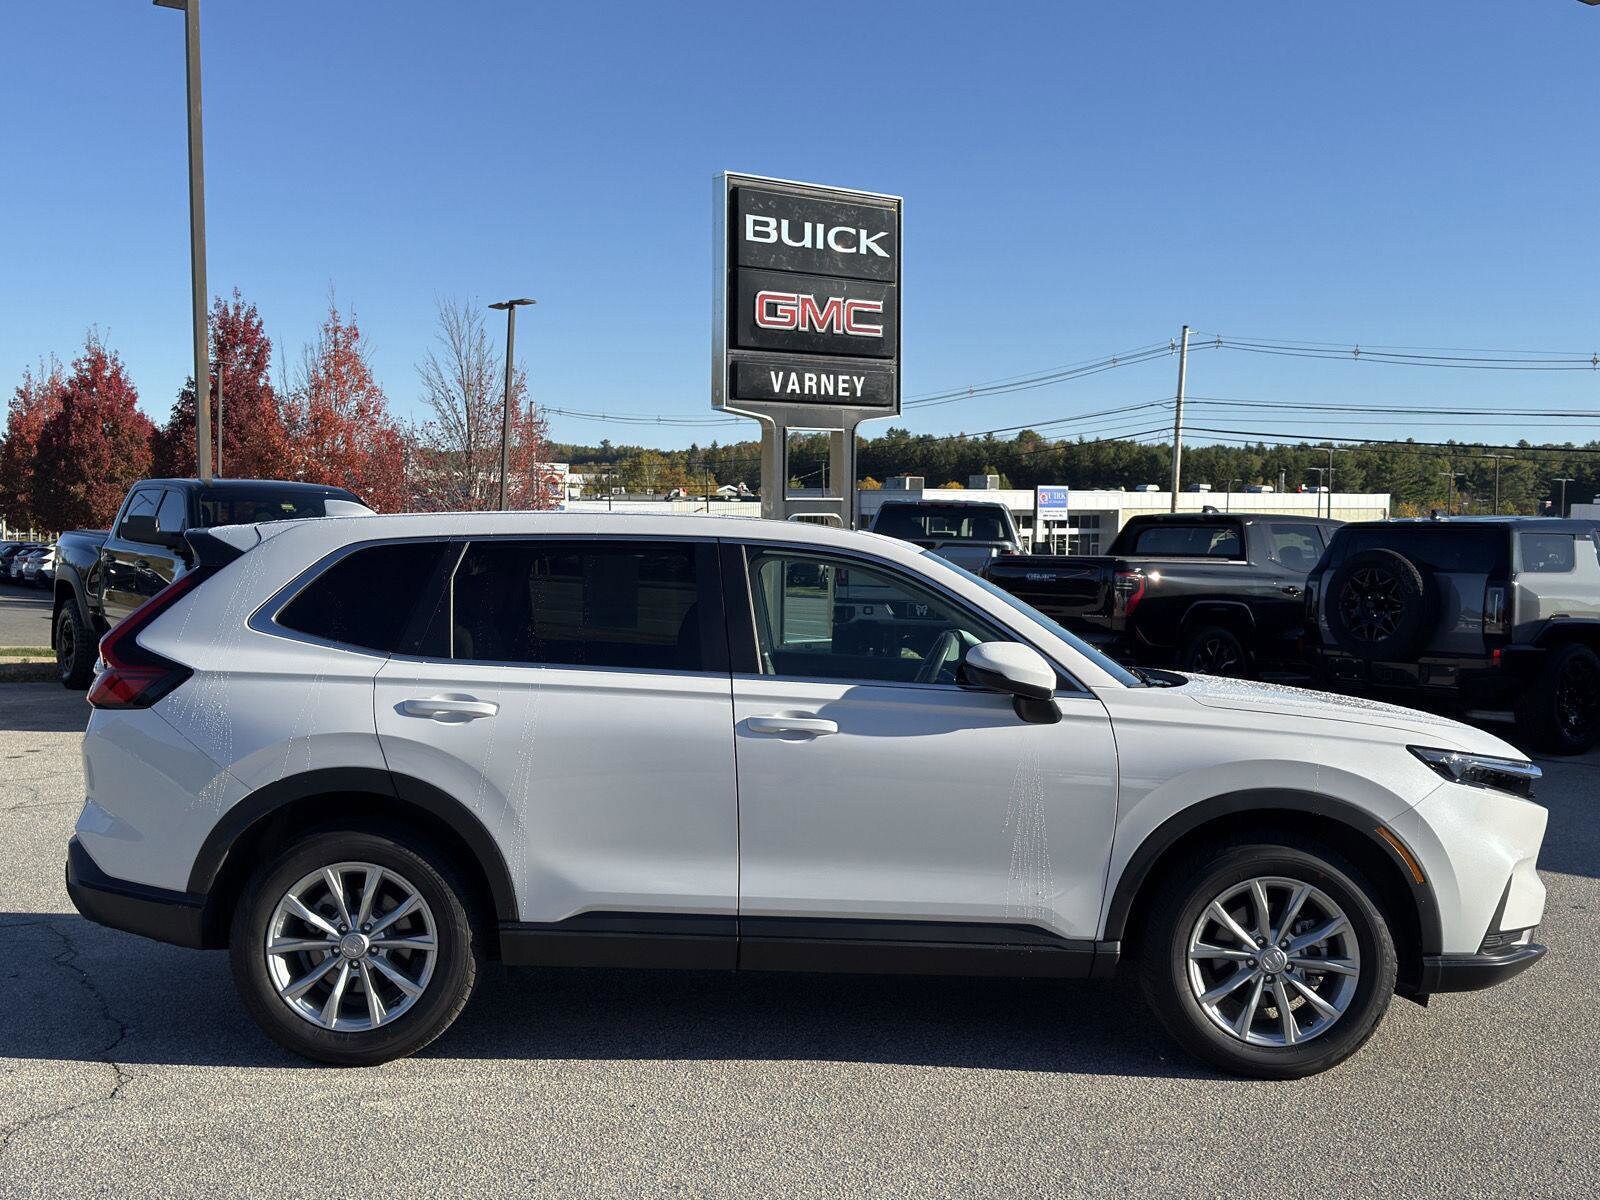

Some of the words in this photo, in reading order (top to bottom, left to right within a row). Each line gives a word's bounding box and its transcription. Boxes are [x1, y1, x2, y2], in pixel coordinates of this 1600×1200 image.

[745, 213, 890, 258] BUICK
[755, 290, 884, 338] GMC
[770, 371, 865, 397] VARNEY
